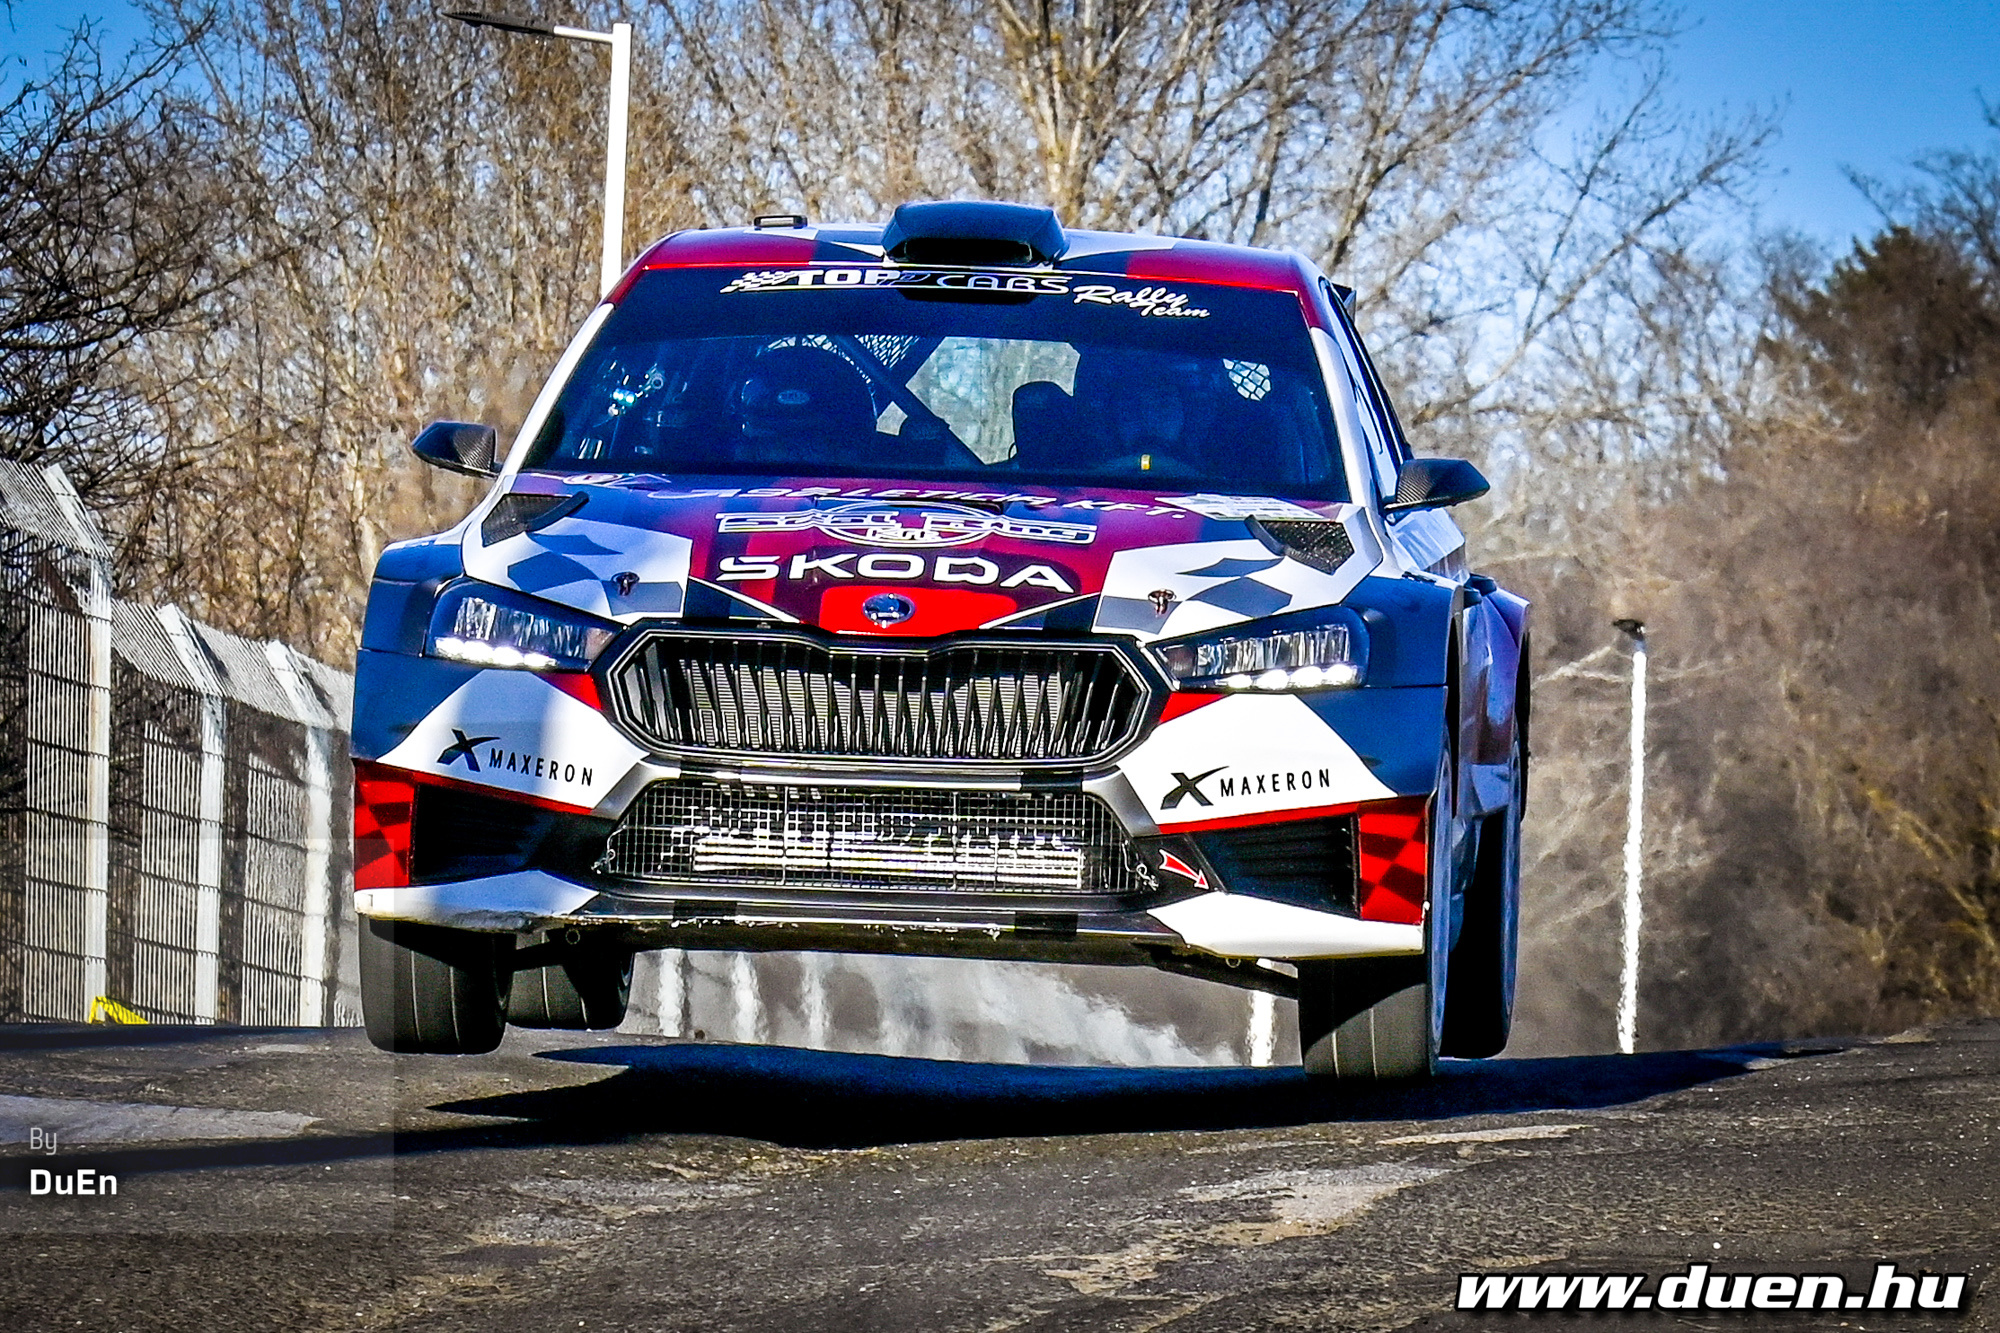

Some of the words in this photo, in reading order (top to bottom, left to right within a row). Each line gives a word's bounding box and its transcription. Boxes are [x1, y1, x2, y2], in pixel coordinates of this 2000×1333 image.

[936, 274, 1071, 295] CARS
[1071, 284, 1189, 305] Rally
[1129, 300, 1212, 318] Team
[489, 747, 593, 787] MAXERON
[1219, 768, 1331, 797] MAXERON
